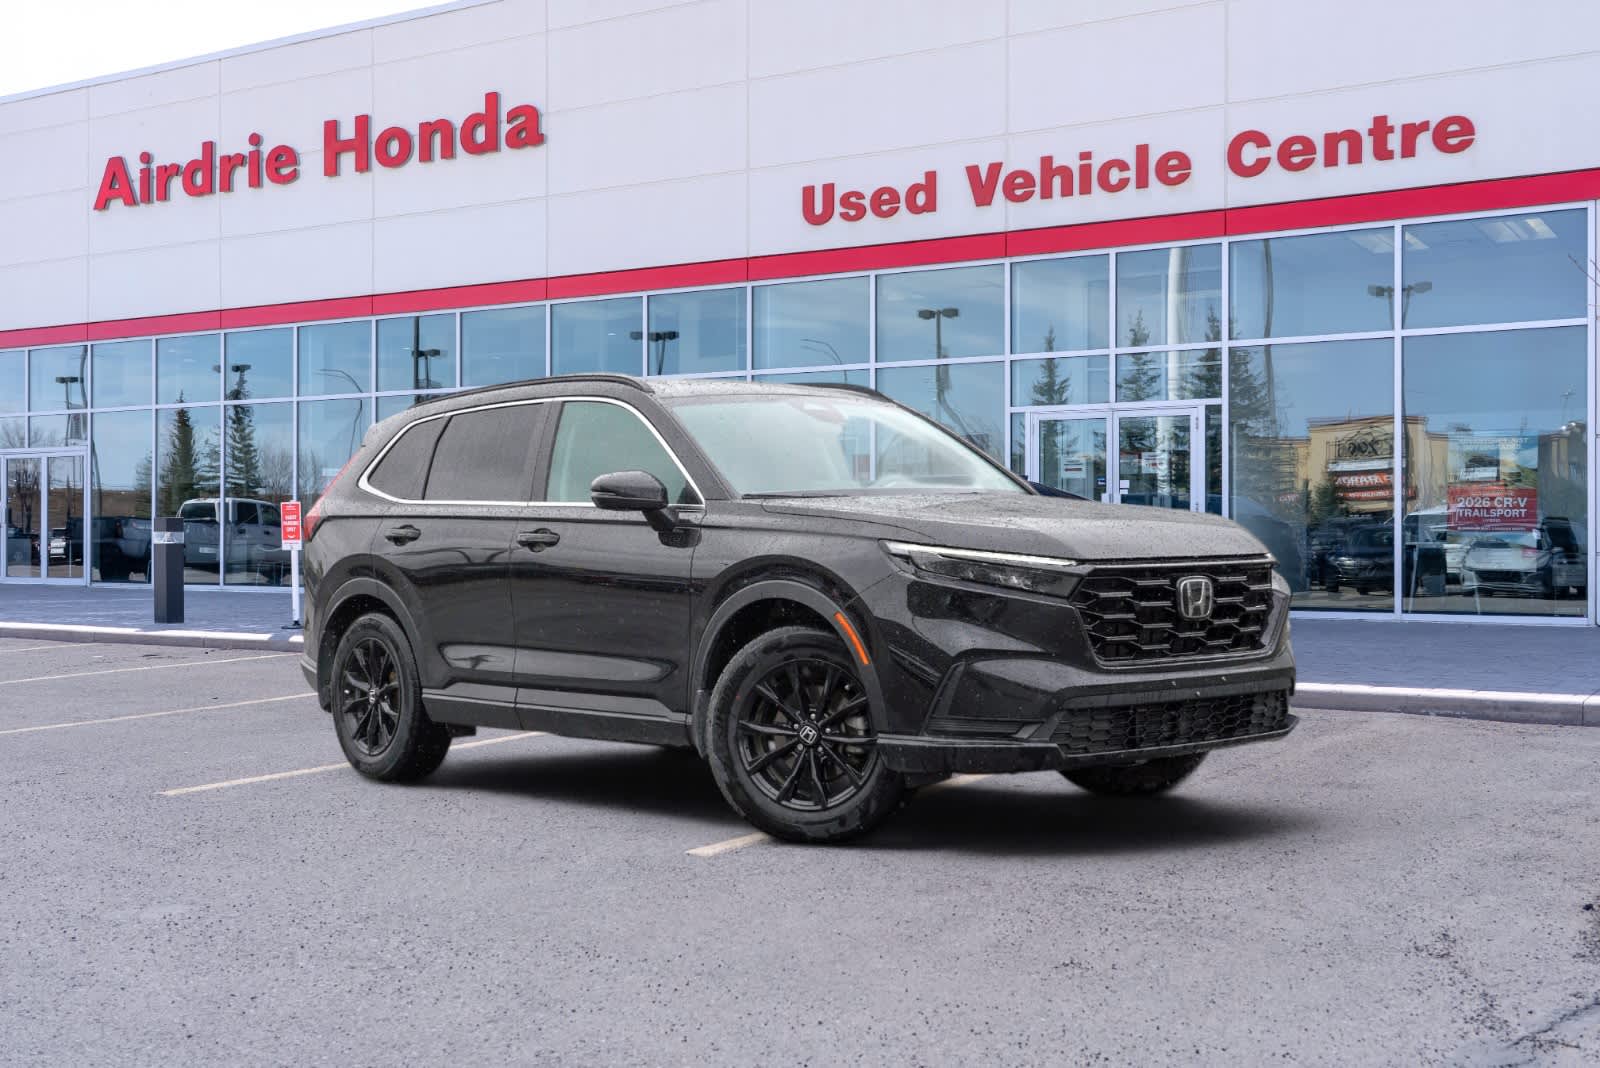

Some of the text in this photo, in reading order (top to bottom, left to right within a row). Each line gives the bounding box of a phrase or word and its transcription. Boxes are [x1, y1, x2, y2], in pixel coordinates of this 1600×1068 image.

[95, 91, 547, 212] Airdrie Honda
[801, 114, 1477, 226] Used Vehicle Centre
[1457, 497, 1528, 508] 2026 CR-V
[1458, 508, 1528, 518] TRAILSPORT
